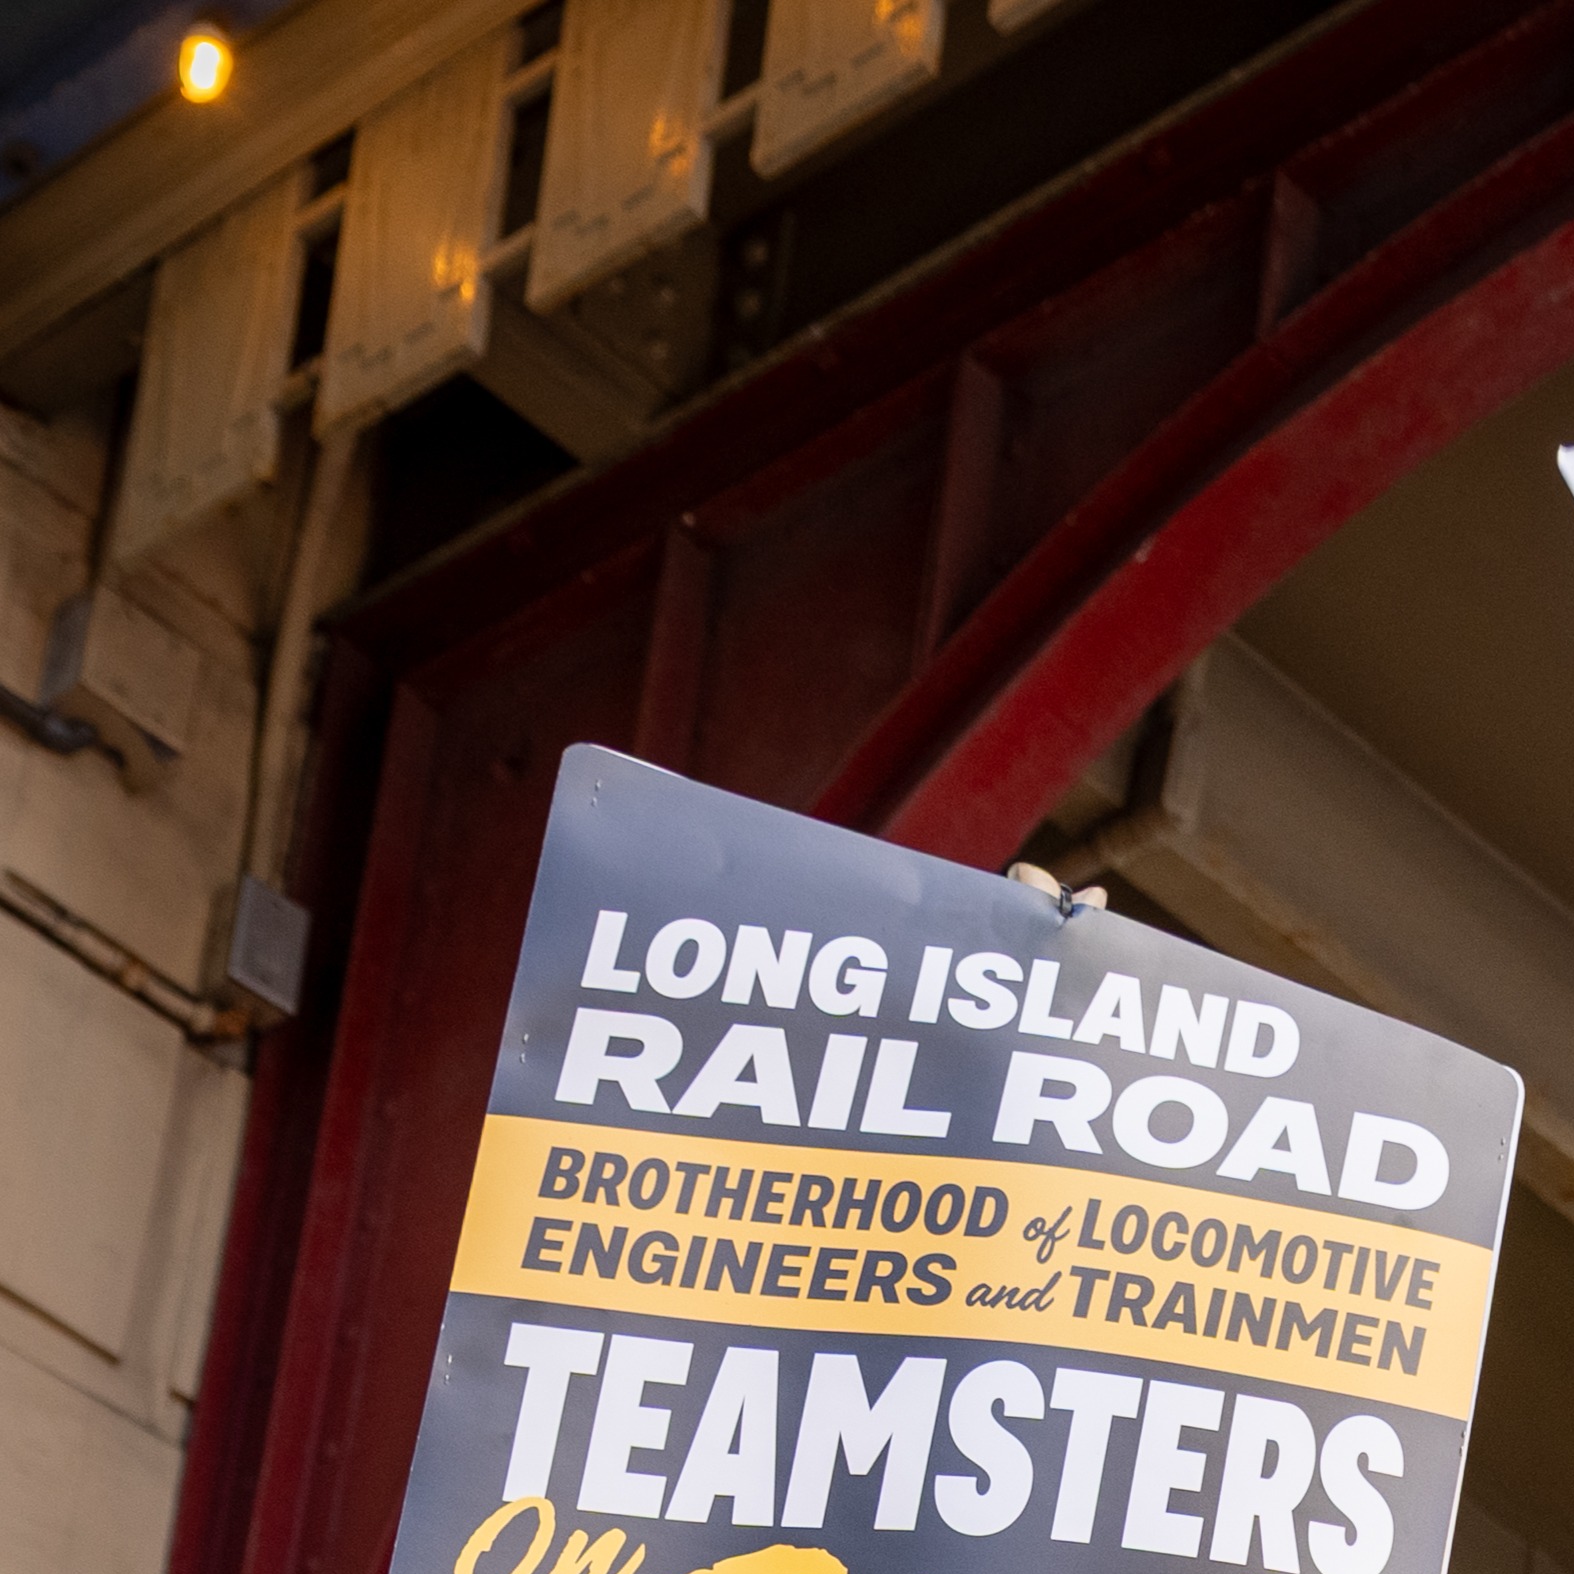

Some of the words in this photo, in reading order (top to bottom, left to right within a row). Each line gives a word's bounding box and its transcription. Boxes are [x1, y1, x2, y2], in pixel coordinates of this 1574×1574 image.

[581, 910, 886, 1019] LONG
[908, 945, 1298, 1077] ISLAND
[553, 1008, 952, 1139] RAIL
[994, 1053, 1450, 1211] ROAD
[520, 1217, 956, 1307] ENGINEERS
[964, 1270, 1063, 1315] and
[1069, 1270, 1426, 1376] TRAINMEN
[537, 1147, 1009, 1238] BROTHERHOOD
[1022, 1203, 1072, 1257] of
[1076, 1198, 1440, 1311] LOCOMOTIVE
